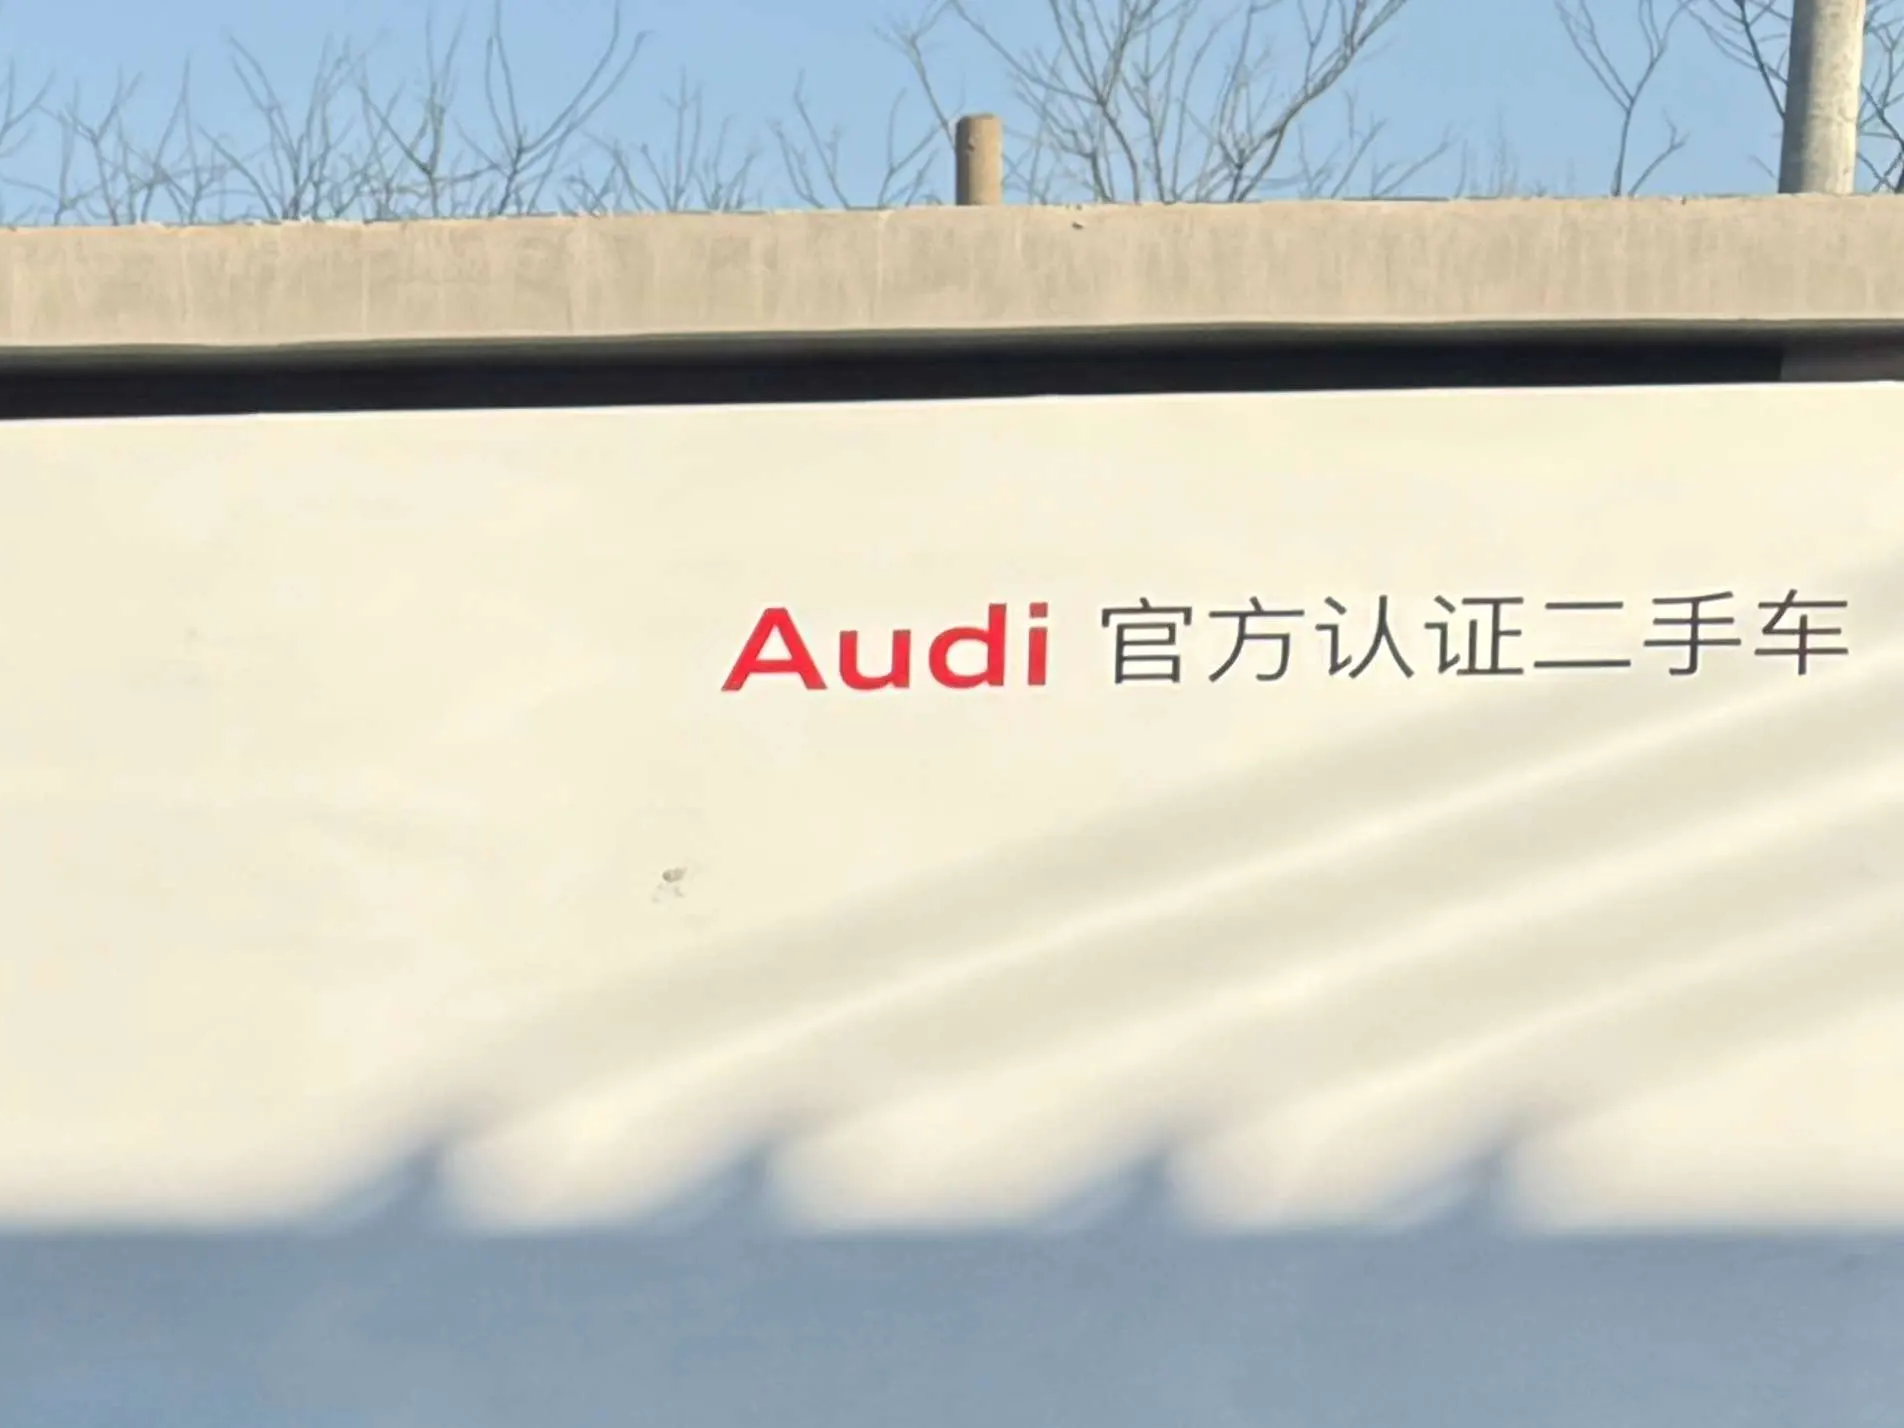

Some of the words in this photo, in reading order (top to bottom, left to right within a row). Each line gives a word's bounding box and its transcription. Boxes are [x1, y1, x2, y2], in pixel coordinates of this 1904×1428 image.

[721, 600, 1049, 692] Audi
[1101, 588, 1850, 685] 官方认证二手车
